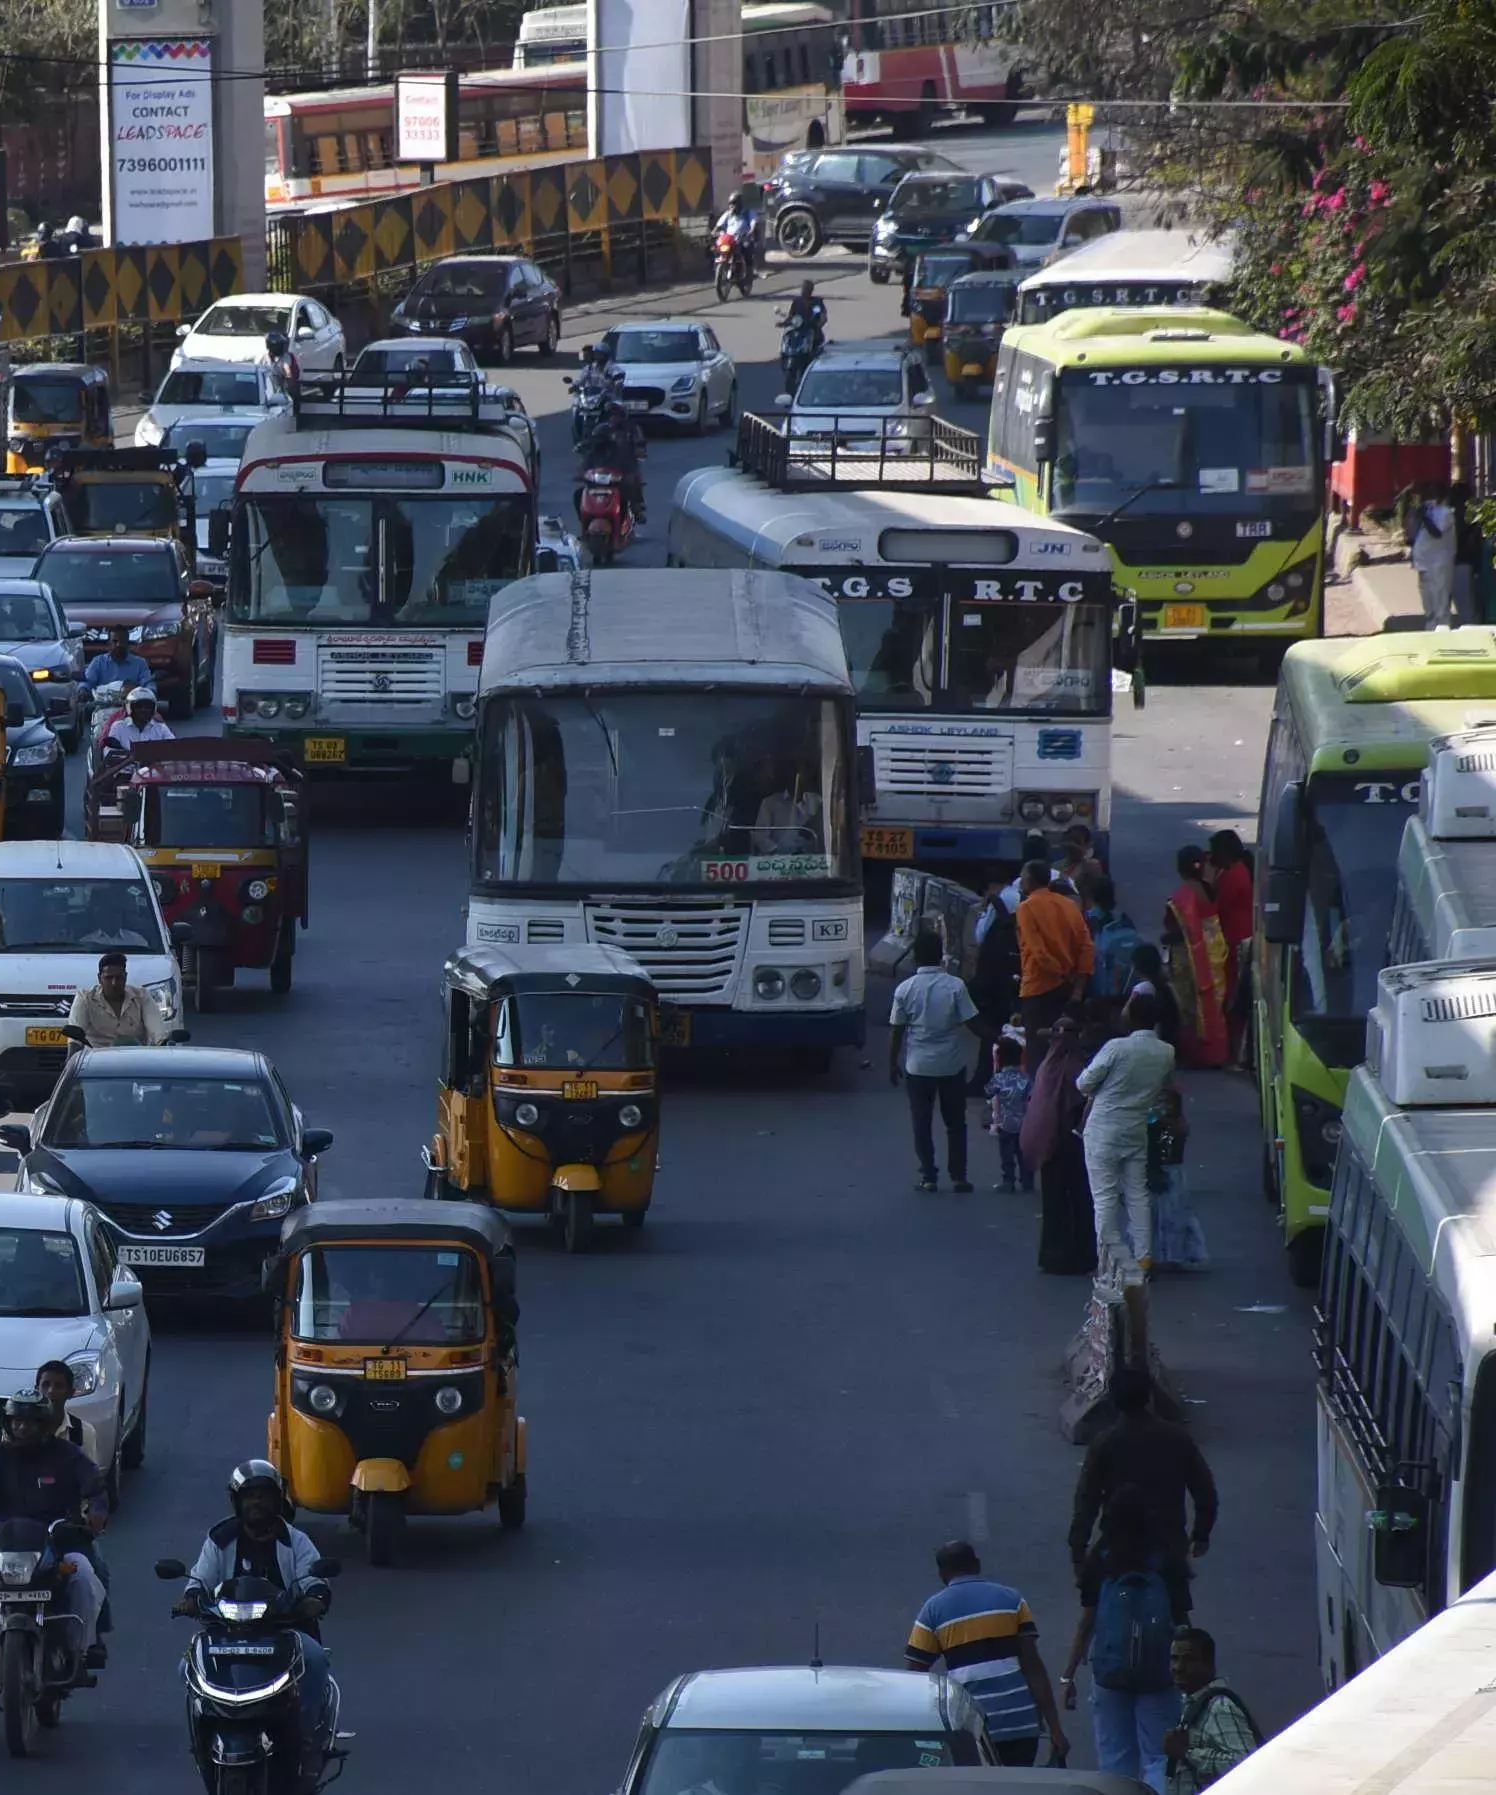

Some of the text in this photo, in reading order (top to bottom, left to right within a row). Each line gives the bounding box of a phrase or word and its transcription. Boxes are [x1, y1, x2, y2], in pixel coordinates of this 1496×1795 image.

[126, 89, 196, 100] For Display Ads
[132, 106, 190, 119] CONTACT
[117, 124, 206, 141] LEADSPACE
[117, 158, 206, 173] 7396001111
[452, 471, 488, 483] HNK
[1037, 543, 1065, 554] JN
[888, 725, 998, 736] ASHOK LEYLAND
[706, 863, 748, 880] 500
[820, 924, 844, 936] KP
[33, 1031, 46, 1041] TG
[127, 1249, 203, 1262] TS10EU6857
